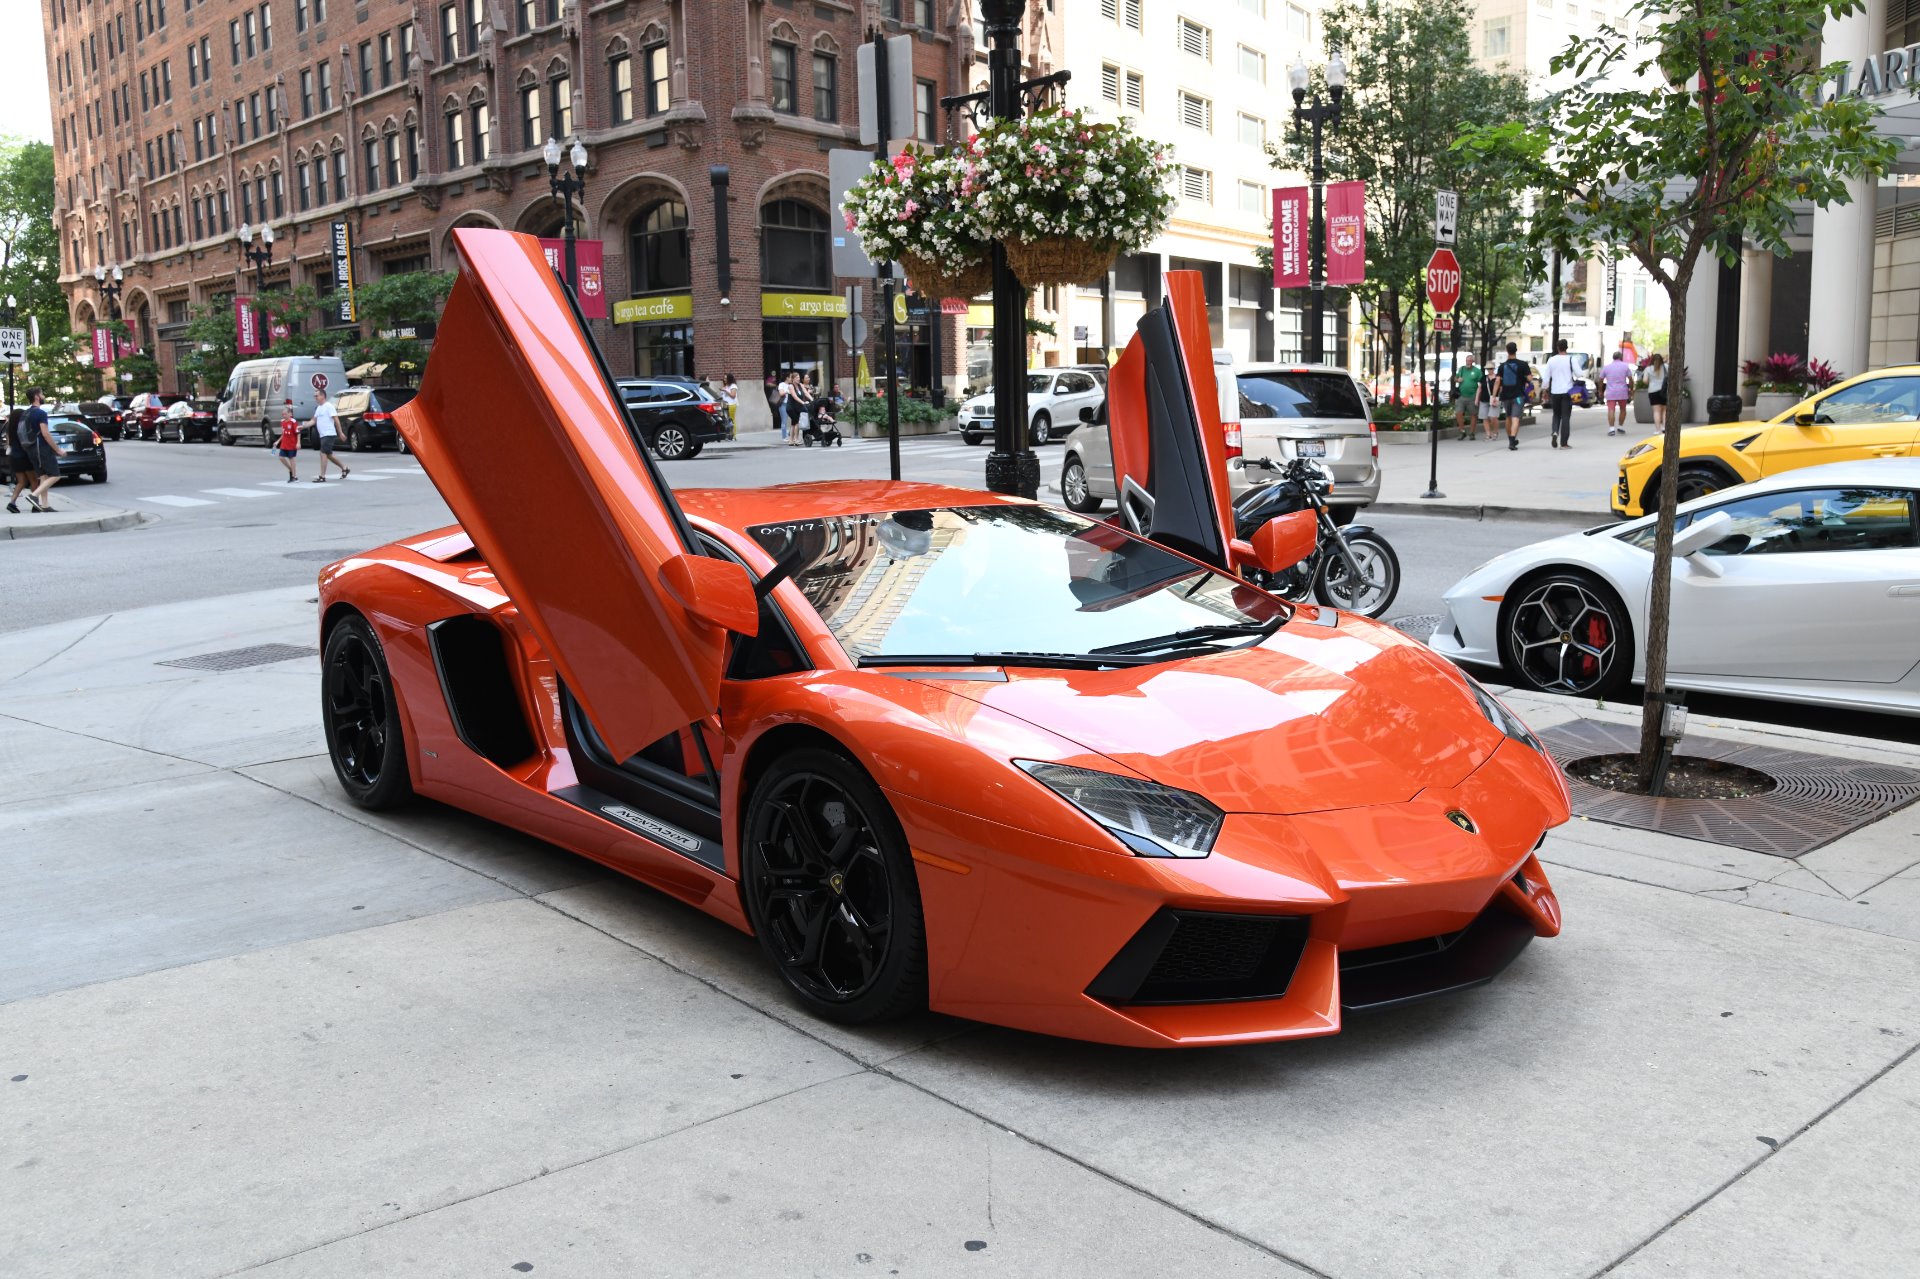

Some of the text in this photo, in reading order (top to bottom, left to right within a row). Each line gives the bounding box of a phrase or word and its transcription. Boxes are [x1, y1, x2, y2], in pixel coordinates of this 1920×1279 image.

[1440, 195, 1455, 208] ONE
[1331, 216, 1360, 224] LOYOLA
[1439, 209, 1455, 223] WAY
[336, 224, 346, 256] BAGELS
[1282, 199, 1293, 275] WELCOME
[1428, 268, 1458, 294] STOP
[620, 298, 674, 320] argo tea café
[800, 301, 821, 315] argo
[824, 301, 834, 312] tea
[241, 304, 250, 346] WELCOME
[2, 331, 22, 340] ONE
[2, 341, 22, 349] WAY
